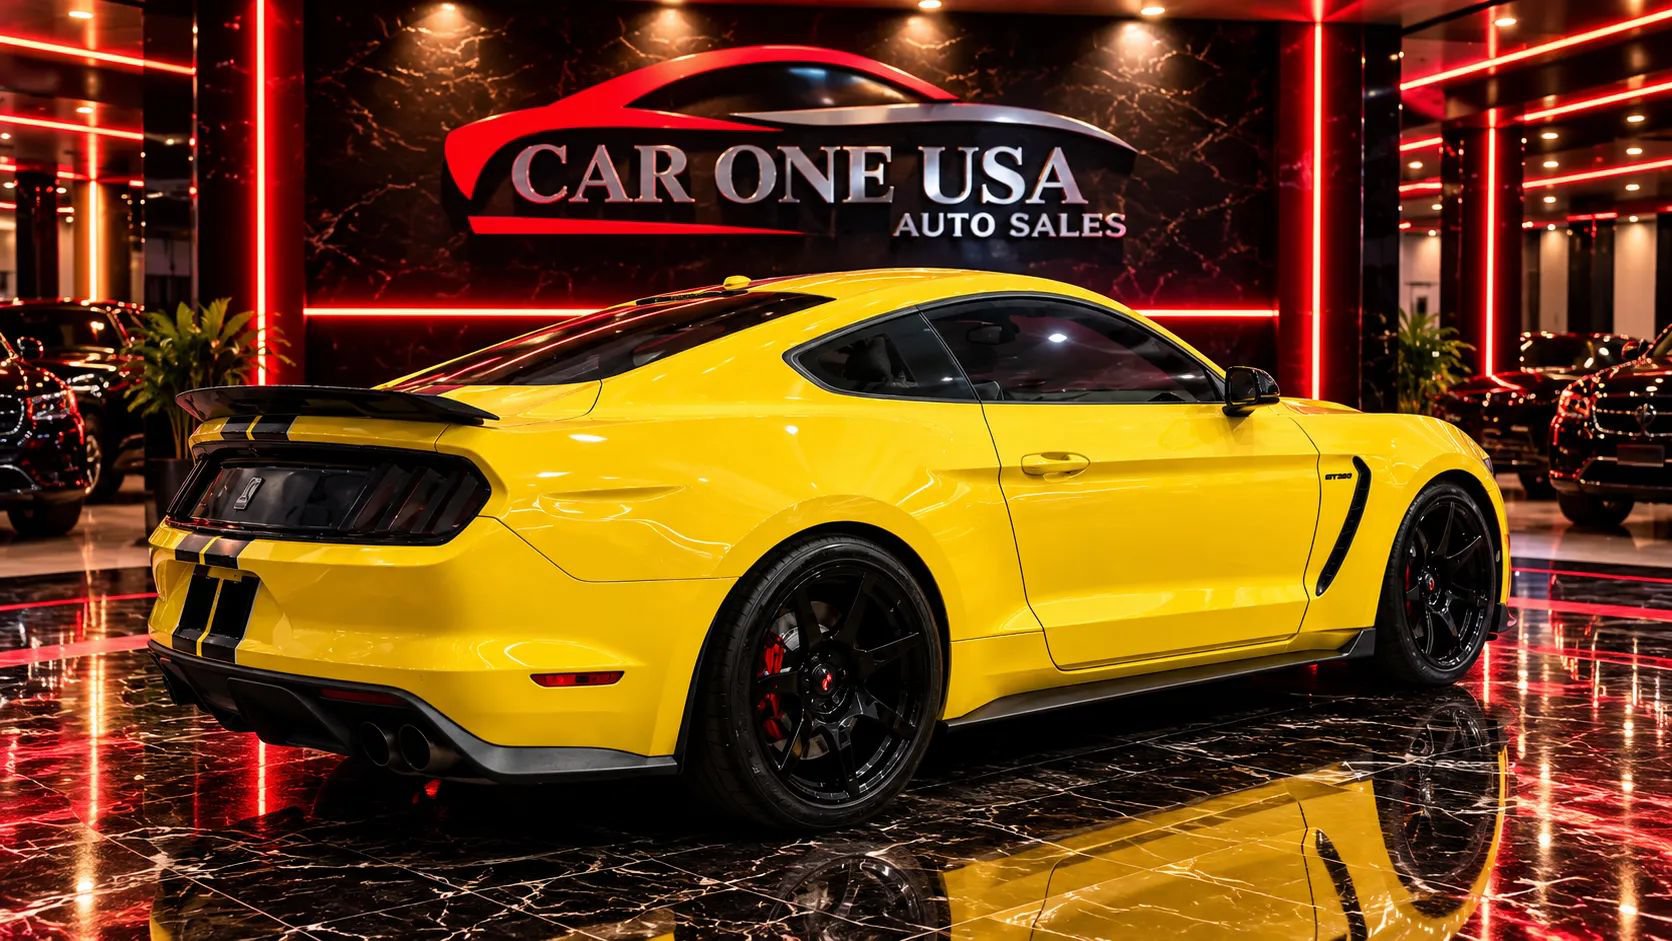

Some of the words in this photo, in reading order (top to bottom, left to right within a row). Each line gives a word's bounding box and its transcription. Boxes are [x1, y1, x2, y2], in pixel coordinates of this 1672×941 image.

[511, 144, 696, 204] CAR
[714, 145, 895, 204] ONE
[918, 146, 1089, 205] USA
[893, 212, 996, 238] AUTO
[1009, 212, 1127, 238] SALES
